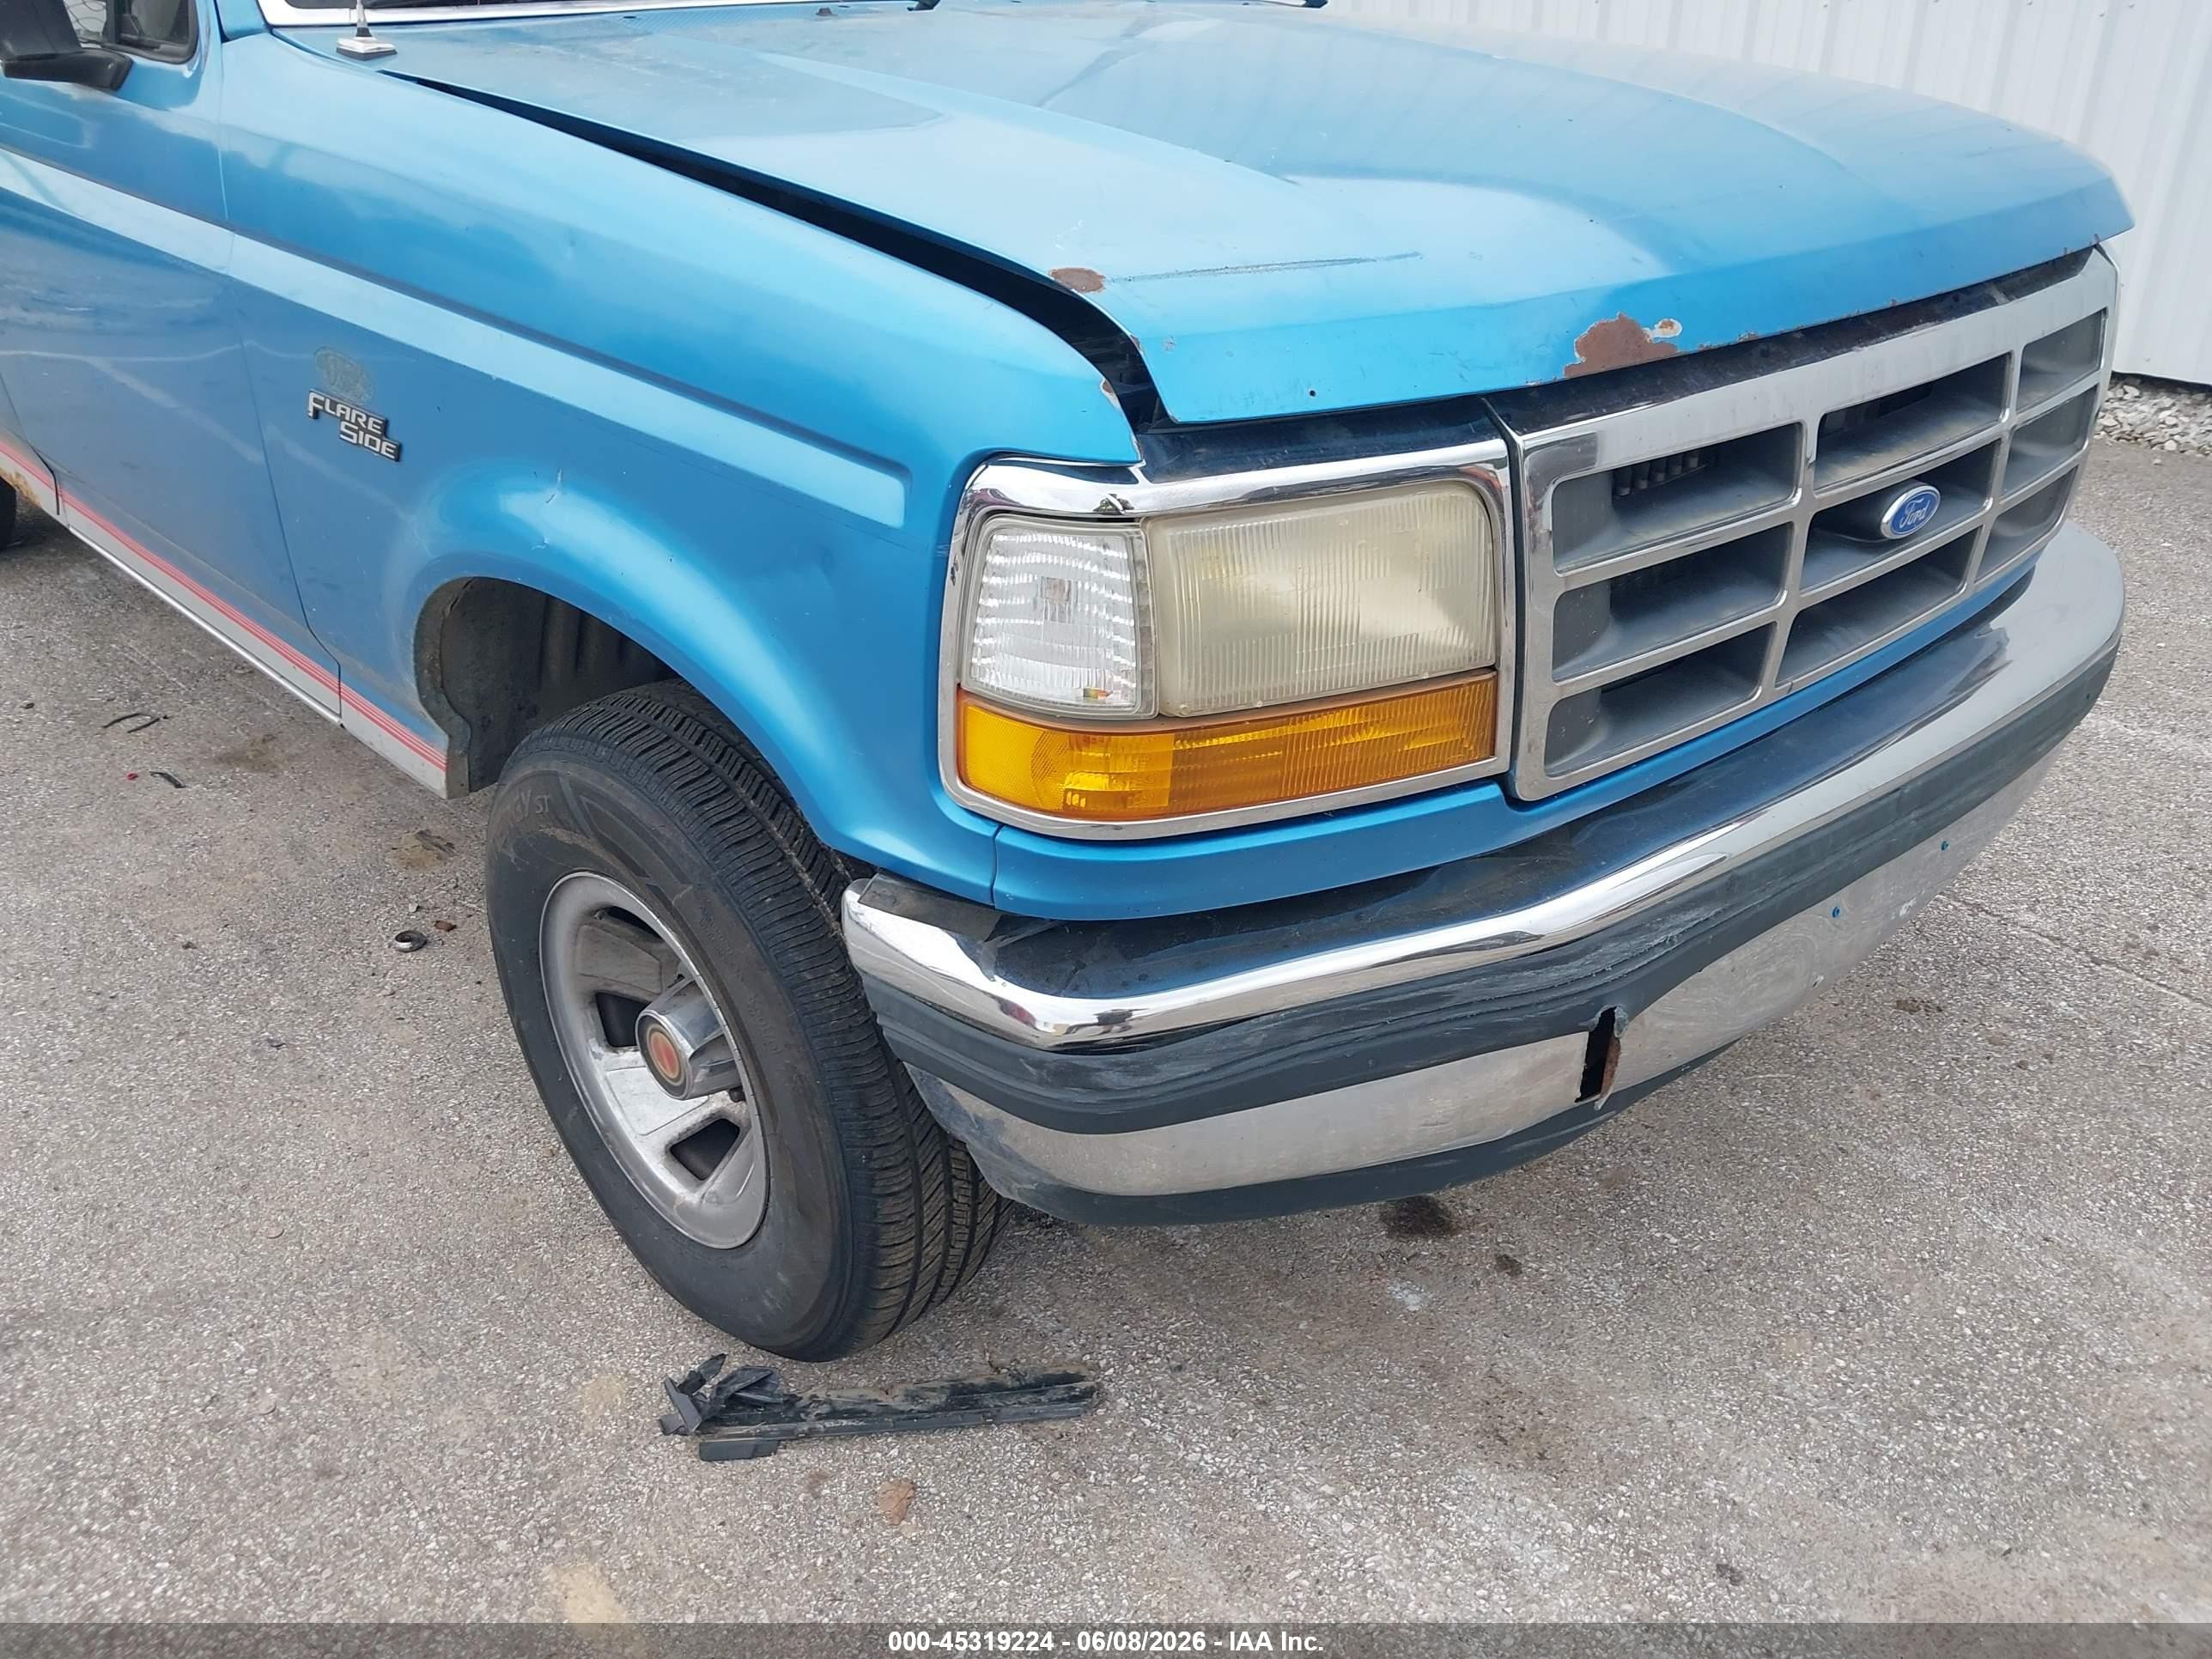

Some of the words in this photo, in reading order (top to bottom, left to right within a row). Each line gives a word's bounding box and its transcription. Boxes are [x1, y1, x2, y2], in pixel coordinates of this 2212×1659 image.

[307, 391, 384, 435] FLARE
[339, 420, 398, 459] SIDE
[1899, 497, 1931, 529] Ford
